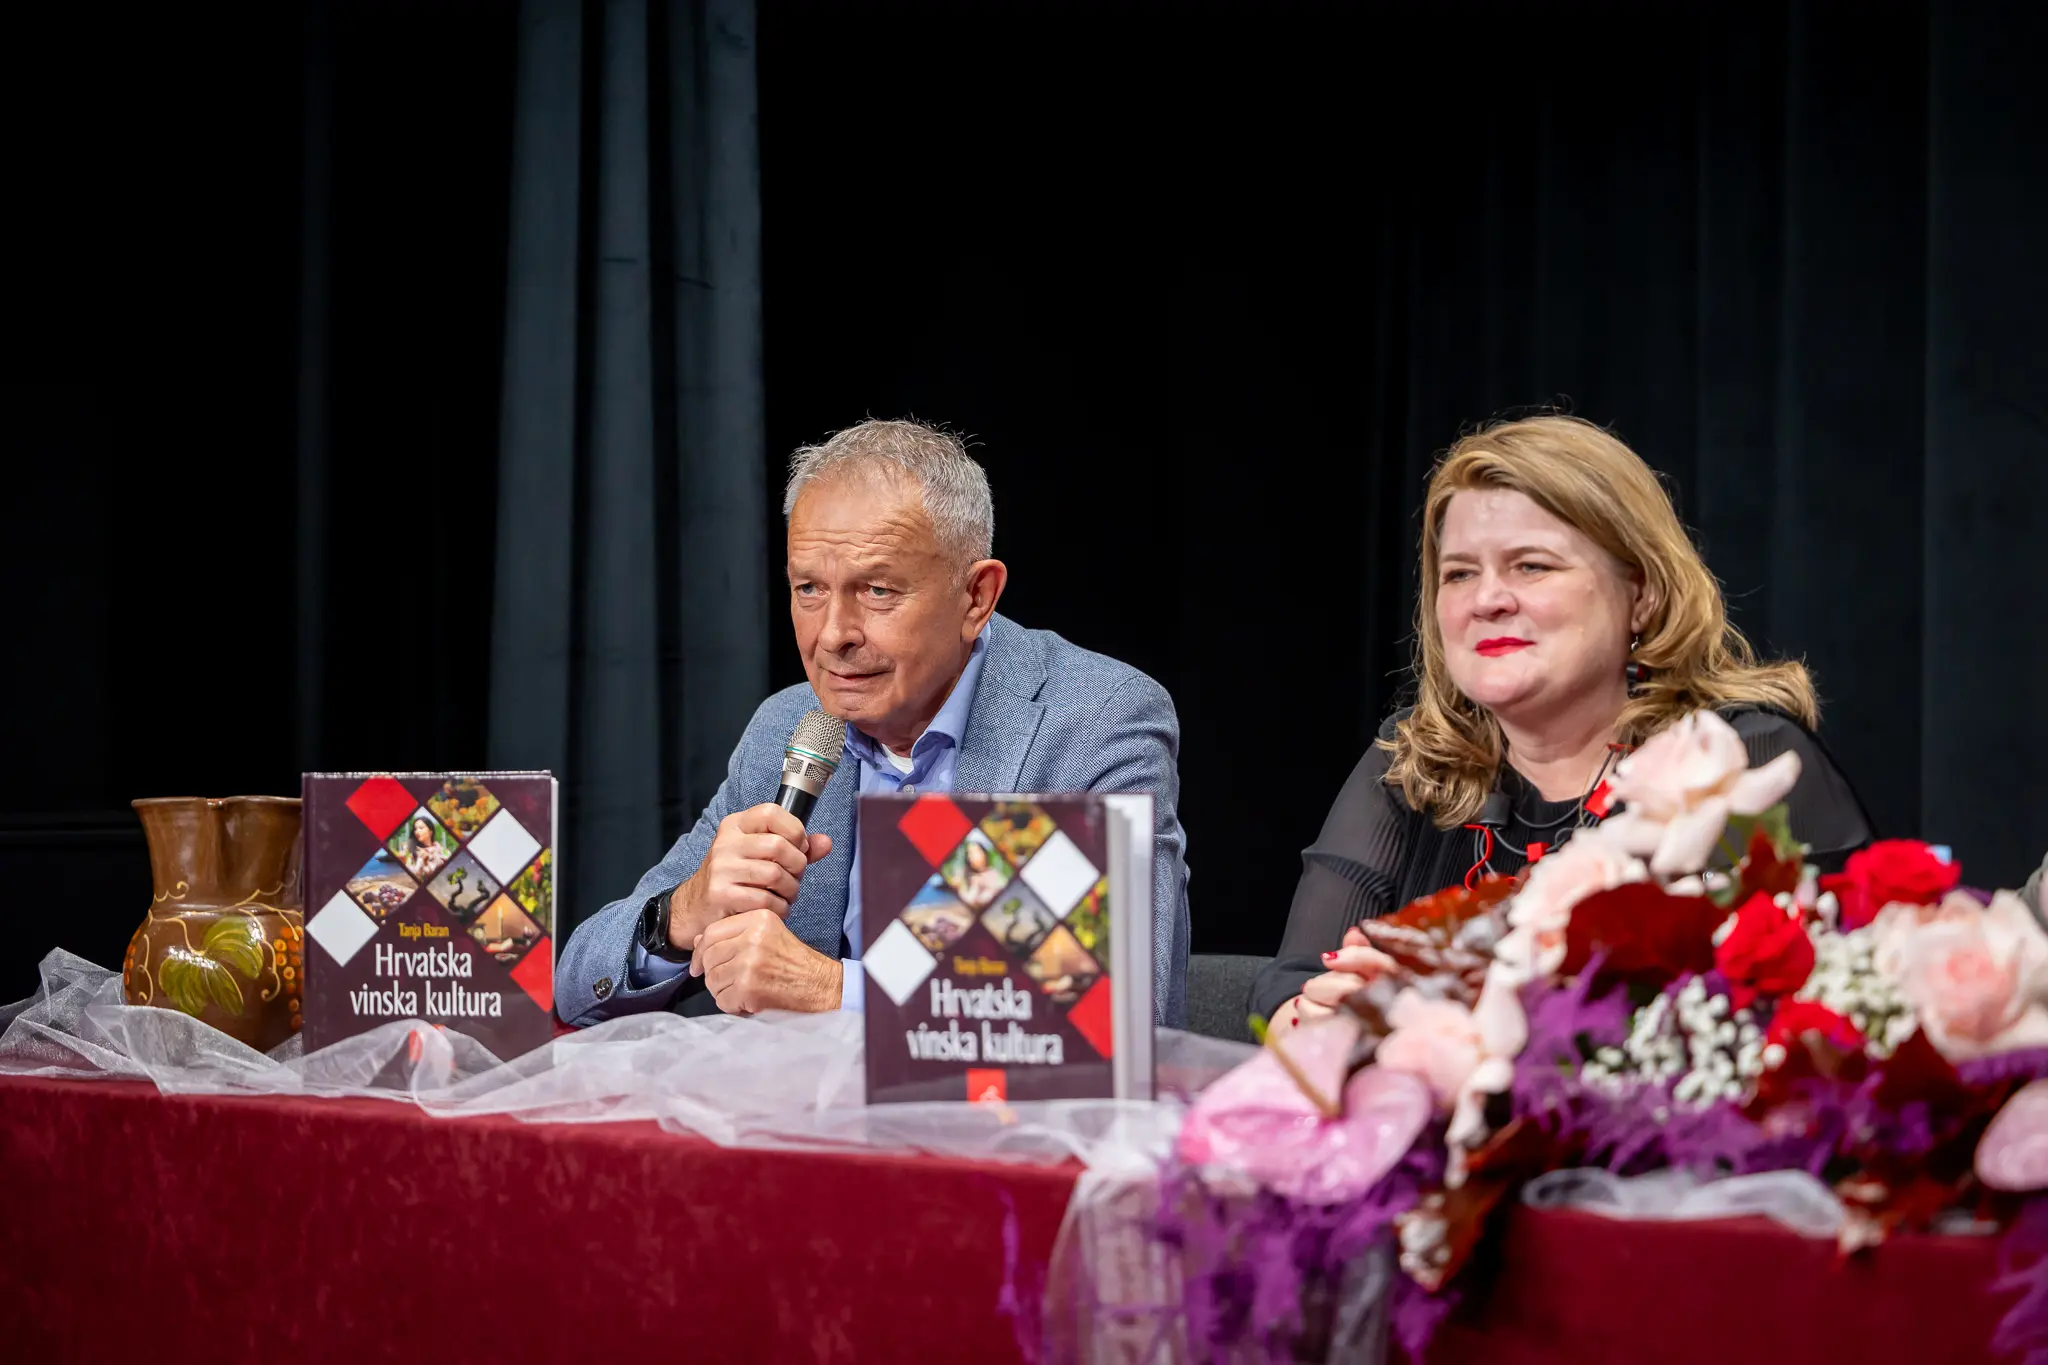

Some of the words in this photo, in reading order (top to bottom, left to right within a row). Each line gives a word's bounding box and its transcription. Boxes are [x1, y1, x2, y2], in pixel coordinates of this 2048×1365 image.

[398, 922, 422, 941] Tanja
[424, 922, 450, 938] Baran
[375, 941, 473, 977] Hrvatska
[350, 980, 418, 1016] vinska
[425, 981, 502, 1017] kultura
[930, 977, 1032, 1020] Hrvatska
[906, 1019, 978, 1061] vinska
[981, 1020, 1064, 1063] kultura
